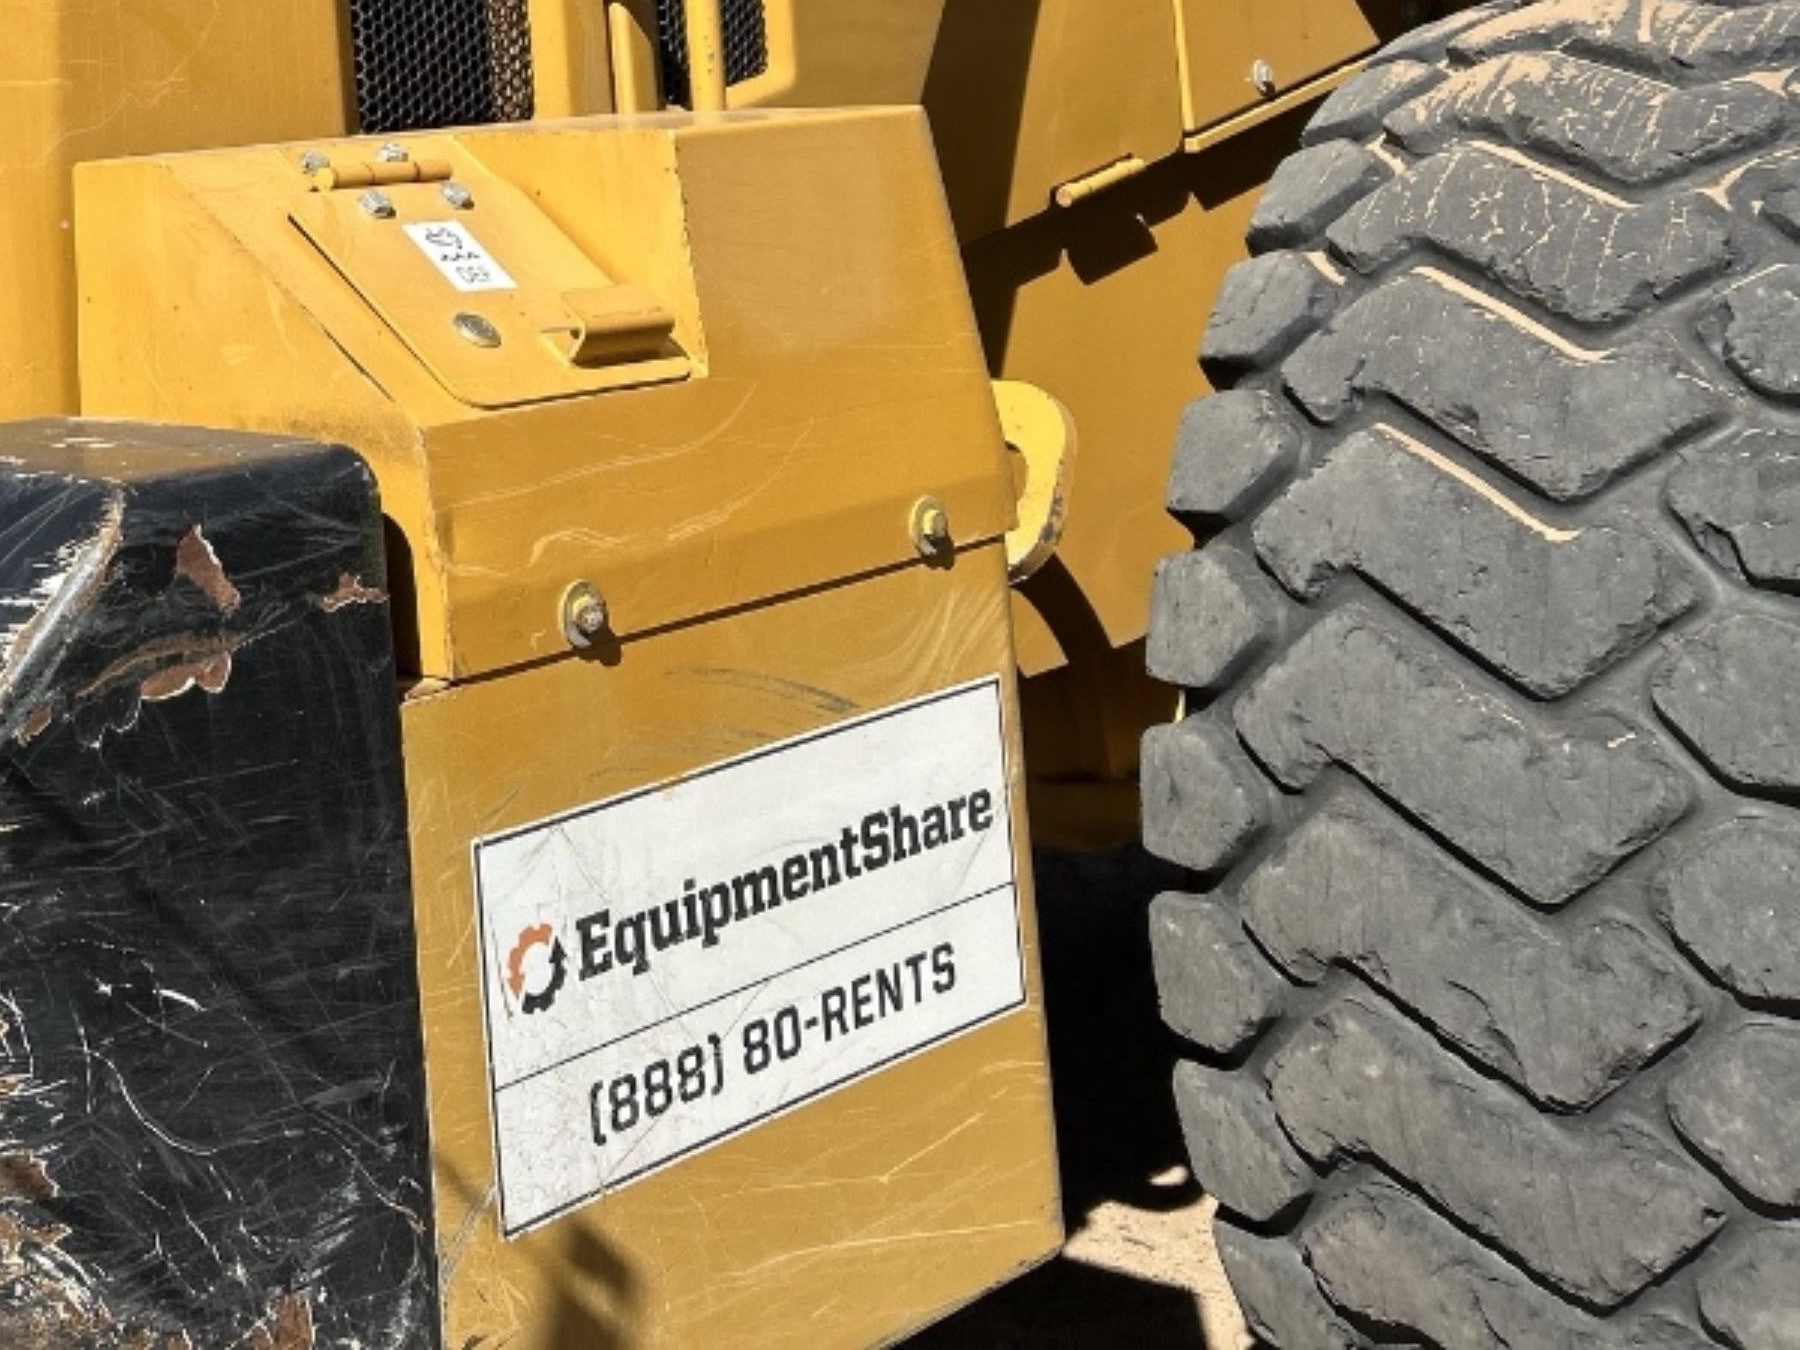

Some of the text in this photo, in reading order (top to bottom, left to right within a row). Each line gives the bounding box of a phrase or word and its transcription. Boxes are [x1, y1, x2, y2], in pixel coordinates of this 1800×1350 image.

[574, 788, 994, 980] EquipmentShare
[588, 942, 958, 1146] (888) 80-RENTS
